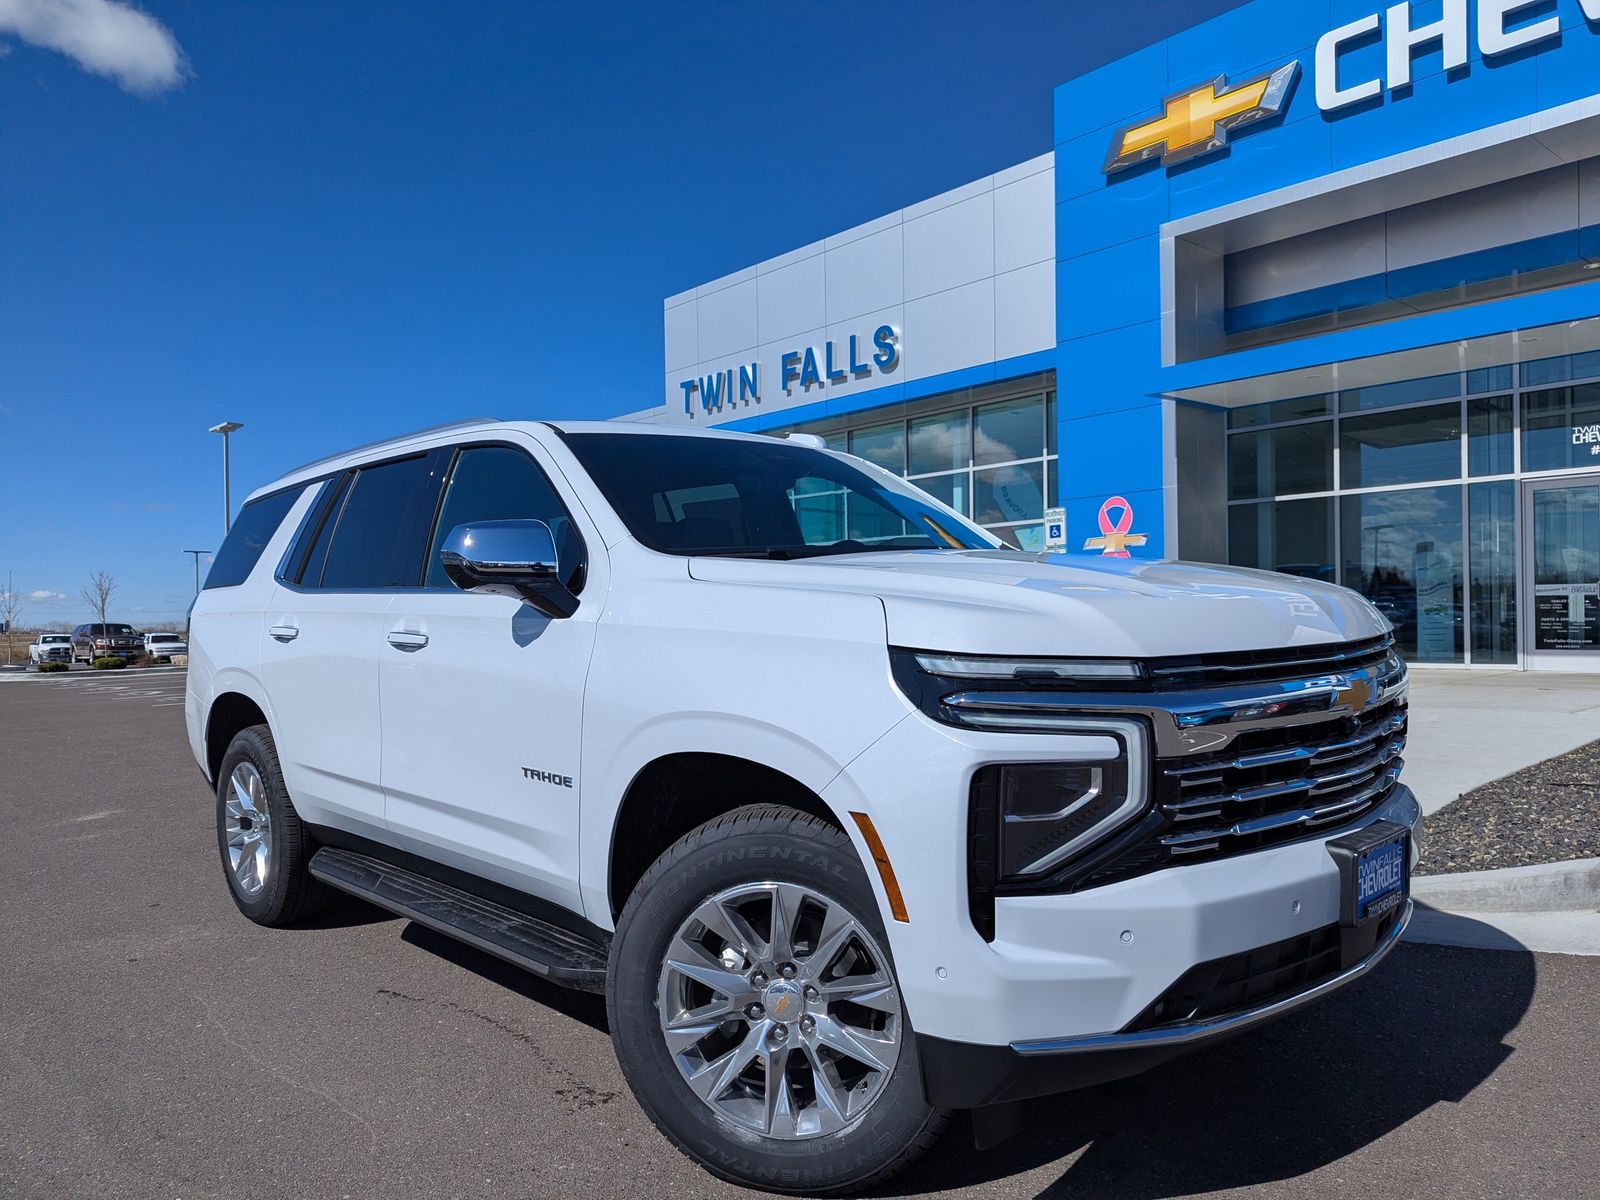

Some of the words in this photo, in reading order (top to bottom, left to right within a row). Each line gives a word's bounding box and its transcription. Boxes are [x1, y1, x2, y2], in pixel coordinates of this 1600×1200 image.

[1315, 0, 1600, 110] CHE
[680, 362, 759, 415] TWIN
[781, 324, 898, 391] FALLS
[521, 766, 573, 789] TAHOE
